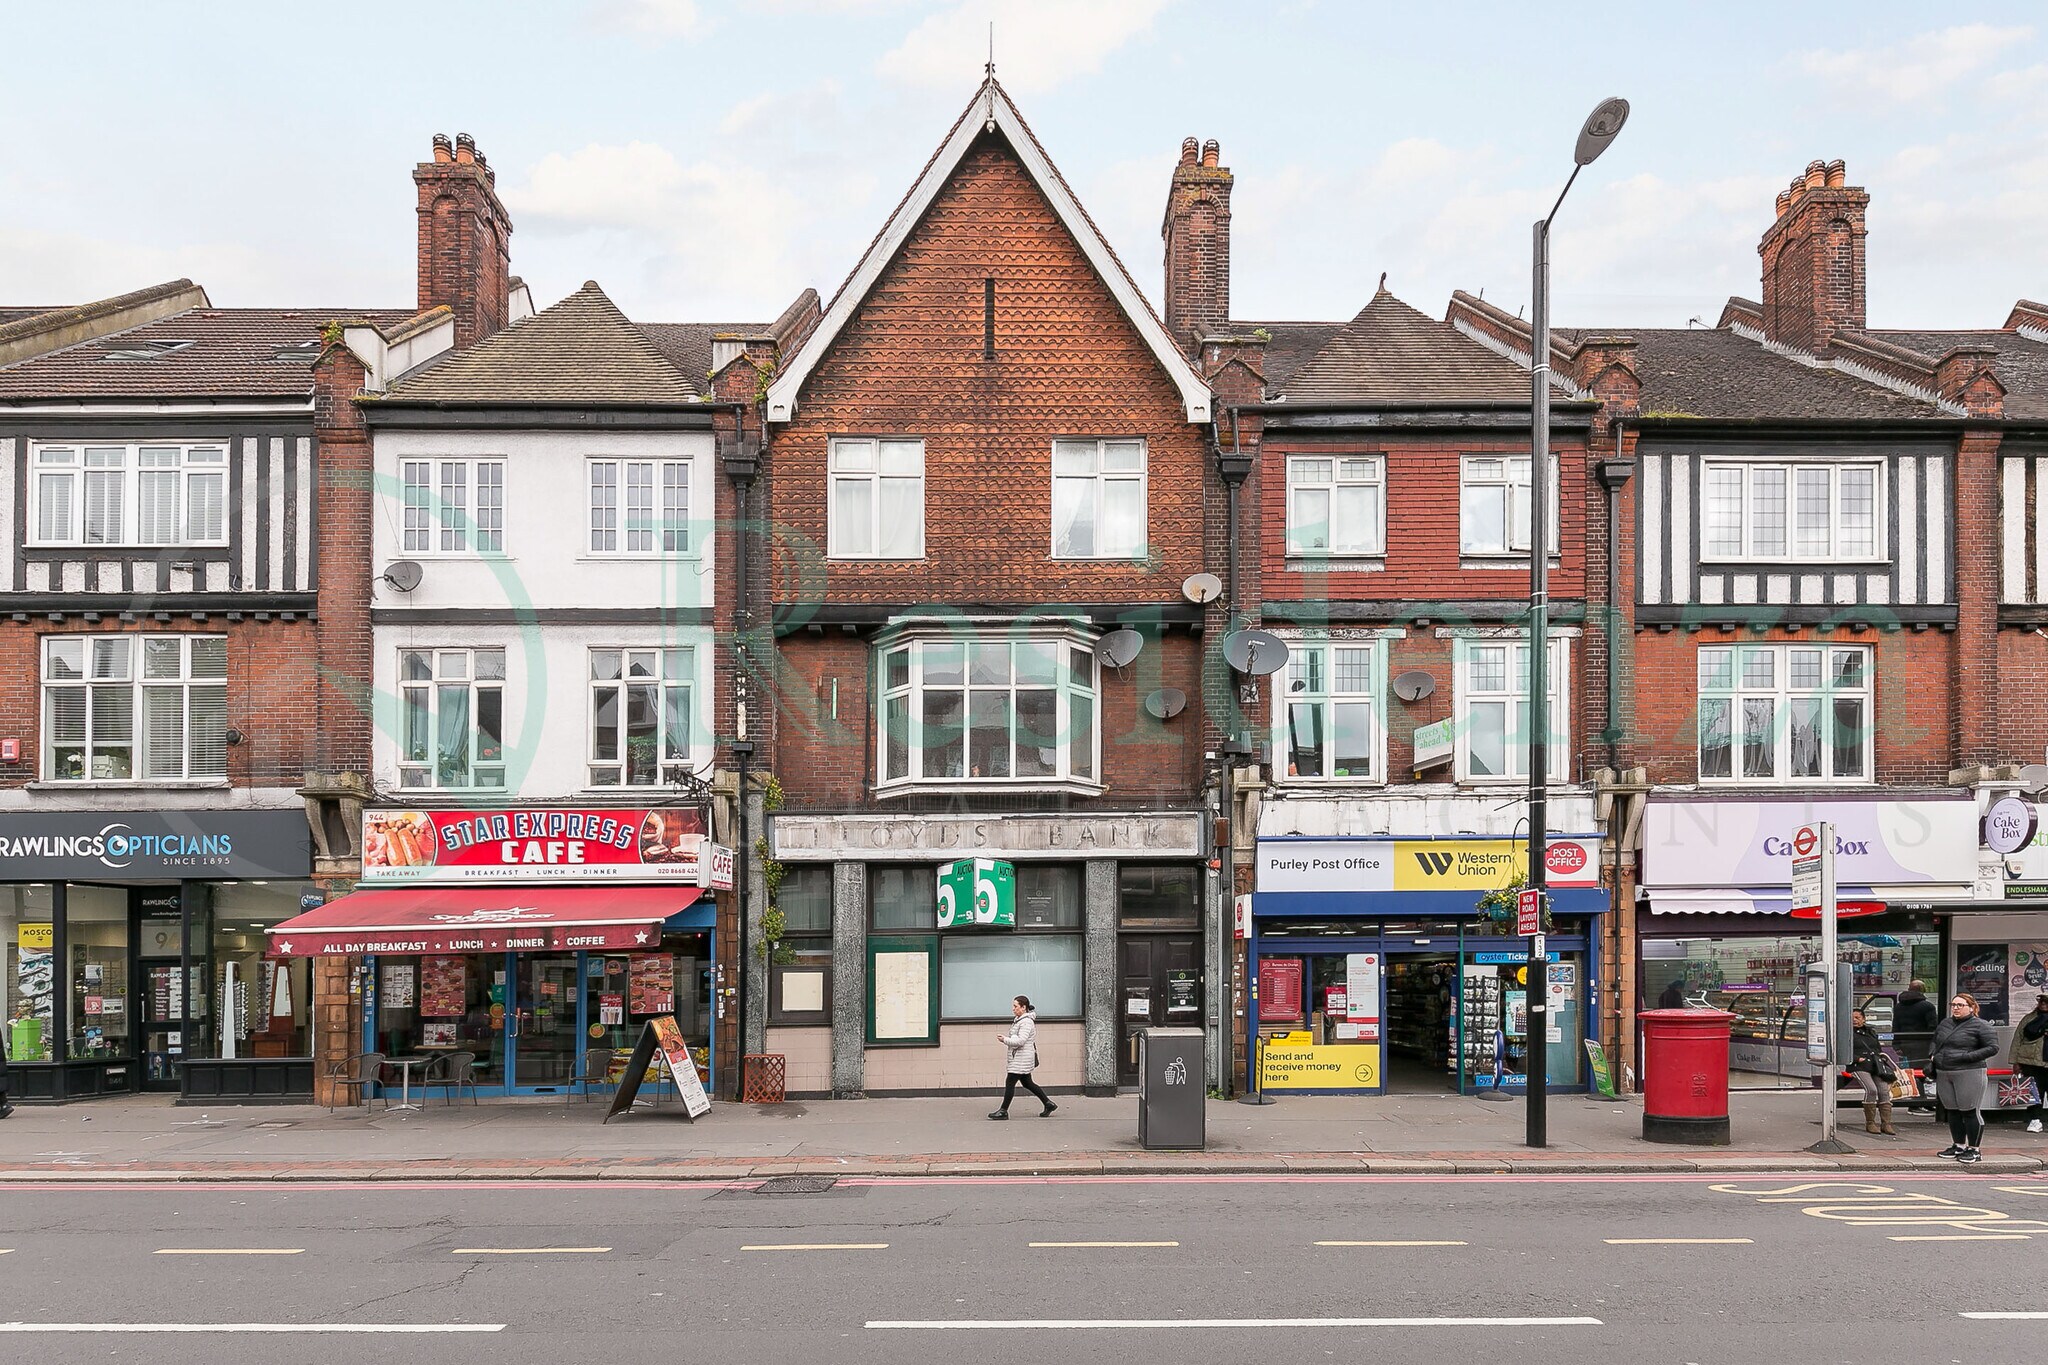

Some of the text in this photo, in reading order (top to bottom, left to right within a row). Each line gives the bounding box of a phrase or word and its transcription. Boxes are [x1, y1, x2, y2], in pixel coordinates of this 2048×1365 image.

[1415, 727, 1439, 740] streets
[1419, 735, 1441, 749] ahead
[369, 814, 384, 822] 944
[1993, 816, 2021, 829] Cake
[441, 811, 635, 851] STAR EXPRESS
[1049, 822, 1170, 849] BANK
[2001, 828, 2021, 839] Box
[0, 835, 232, 857] RAWLINGS OPTICIANS
[501, 840, 586, 864] CAFE
[1553, 848, 1579, 858] POST
[203, 857, 230, 865] 1895
[1457, 852, 1512, 864] Western
[1546, 857, 1582, 867] OFFICE
[712, 854, 732, 874] CAFE
[1270, 858, 1380, 872] Purley Post Office
[1457, 864, 1496, 876] Union
[1522, 894, 1534, 904] NEW
[1521, 903, 1535, 913] ROAD
[1520, 912, 1537, 923] LAYOUT
[1520, 922, 1537, 932] AHEAD
[323, 936, 605, 953] ALL DAY BREAKFAST LUNCH DINNER COFFEE
[1480, 953, 1505, 962] oyster
[1265, 1052, 1314, 1061] Send and
[1265, 1063, 1342, 1072] receive money
[1265, 1073, 1289, 1081] here
